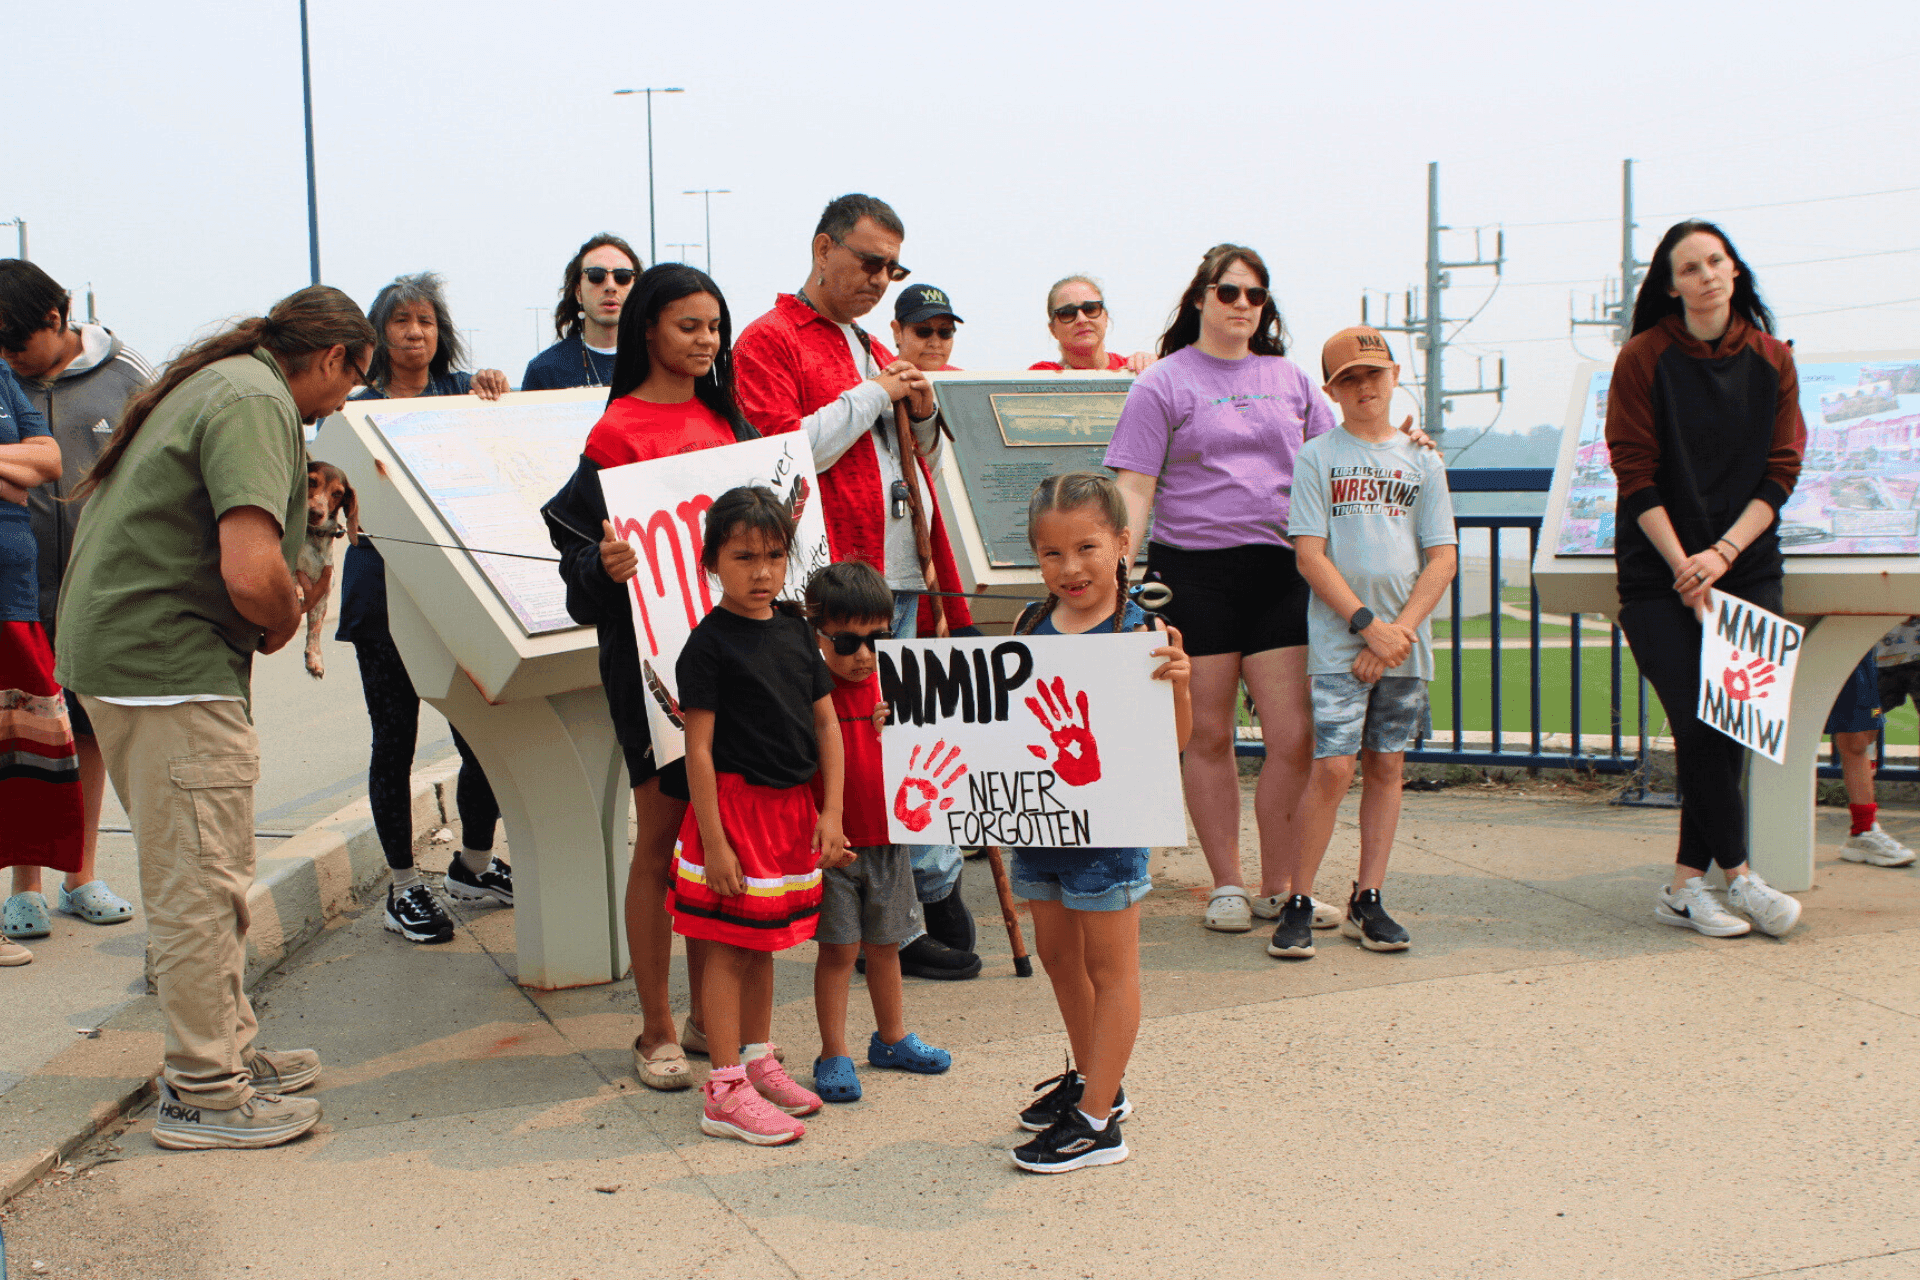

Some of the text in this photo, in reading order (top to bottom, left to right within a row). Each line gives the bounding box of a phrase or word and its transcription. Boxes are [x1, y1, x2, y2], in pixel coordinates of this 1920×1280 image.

[1356, 335, 1383, 348] WAR
[1331, 478, 1420, 507] WRESTLING
[1717, 600, 1801, 667] MMIP
[877, 641, 1034, 728] MMIP
[1703, 678, 1785, 757] MMIW
[968, 770, 1066, 814] NEVER
[947, 809, 1092, 847] FORGOTTEN
[159, 1101, 200, 1124] HOKA
